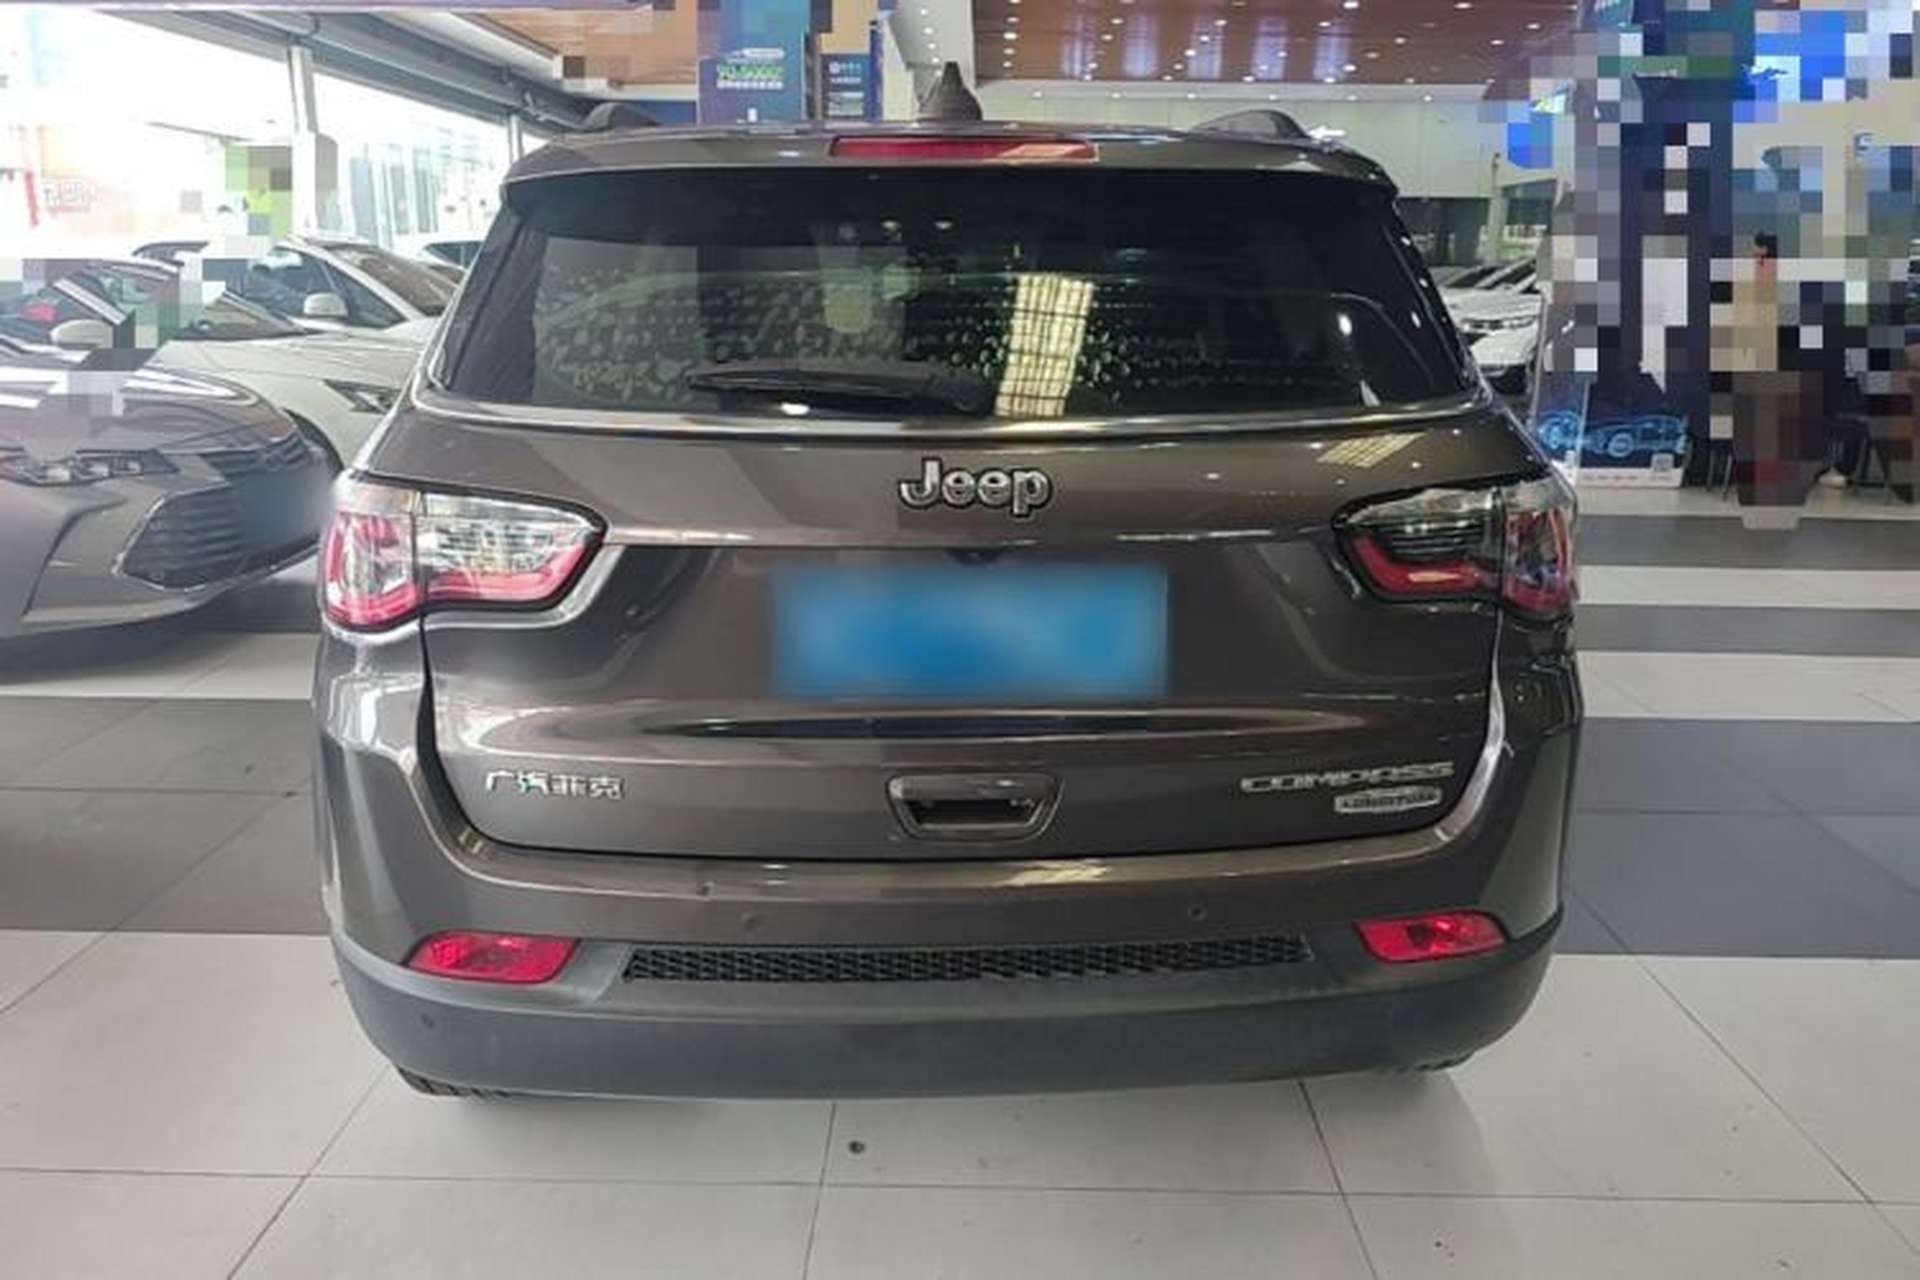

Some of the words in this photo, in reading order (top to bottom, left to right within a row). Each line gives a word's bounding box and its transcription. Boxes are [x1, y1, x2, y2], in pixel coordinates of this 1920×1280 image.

[899, 458, 1051, 517] Jeep
[485, 770, 622, 800] 广汽菲克
[1240, 761, 1454, 793] COMPASS
